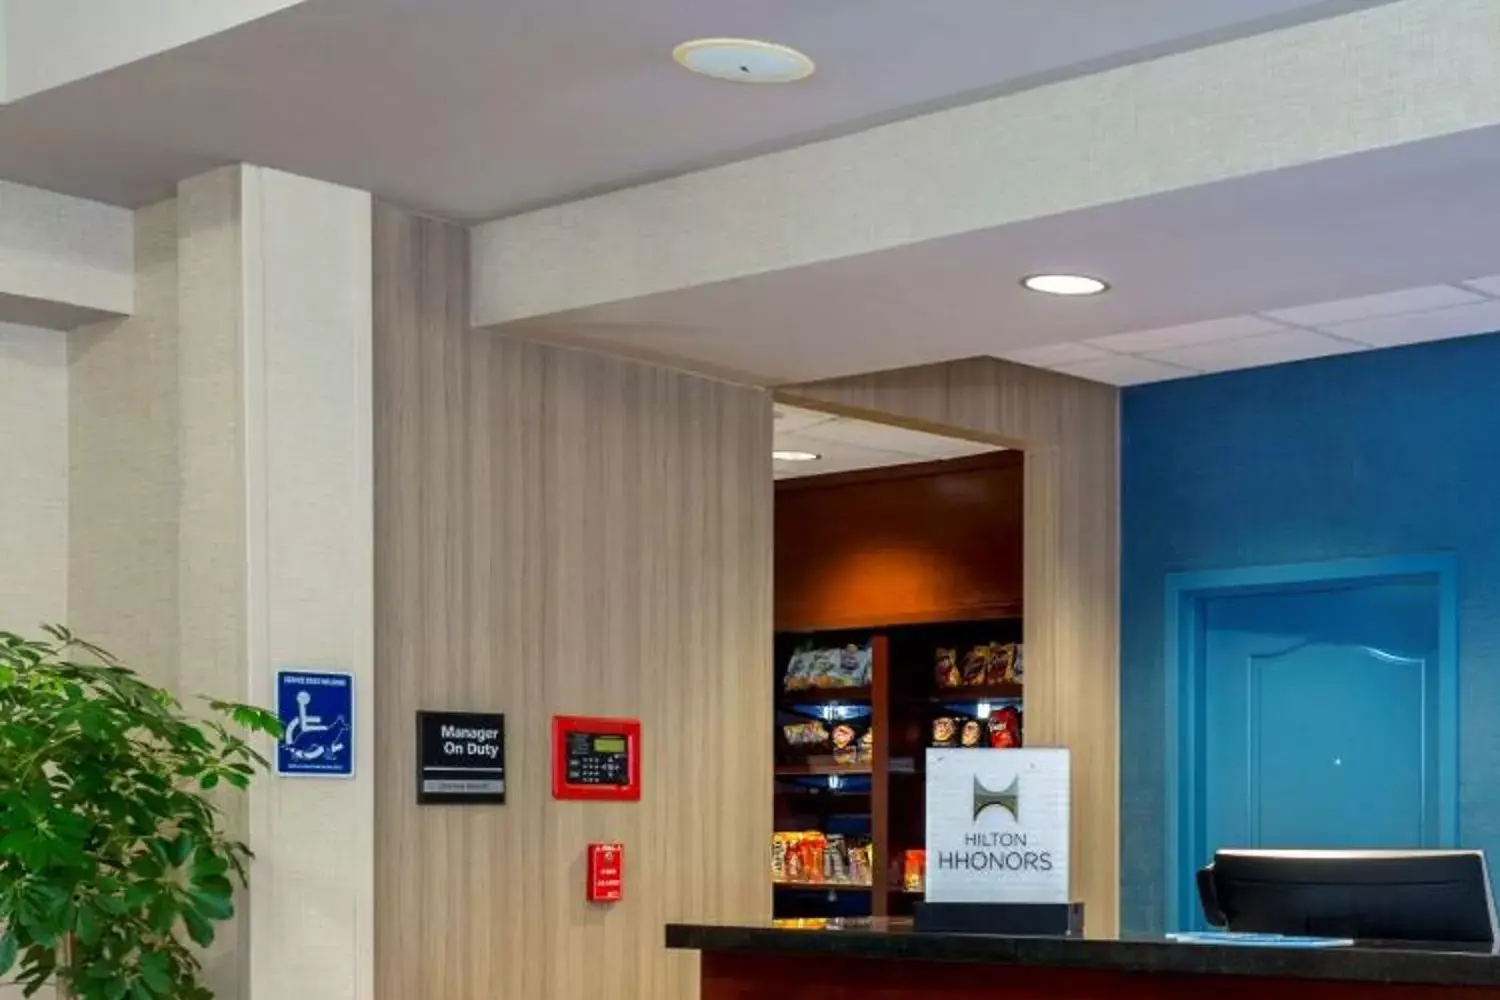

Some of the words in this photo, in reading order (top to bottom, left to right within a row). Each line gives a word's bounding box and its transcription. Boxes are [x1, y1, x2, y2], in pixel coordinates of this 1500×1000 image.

[441, 724, 499, 742] Manager
[444, 741, 464, 755] On
[467, 743, 499, 759] Duty
[965, 832, 1027, 848] HILTON
[938, 850, 1053, 871] HHONORS
